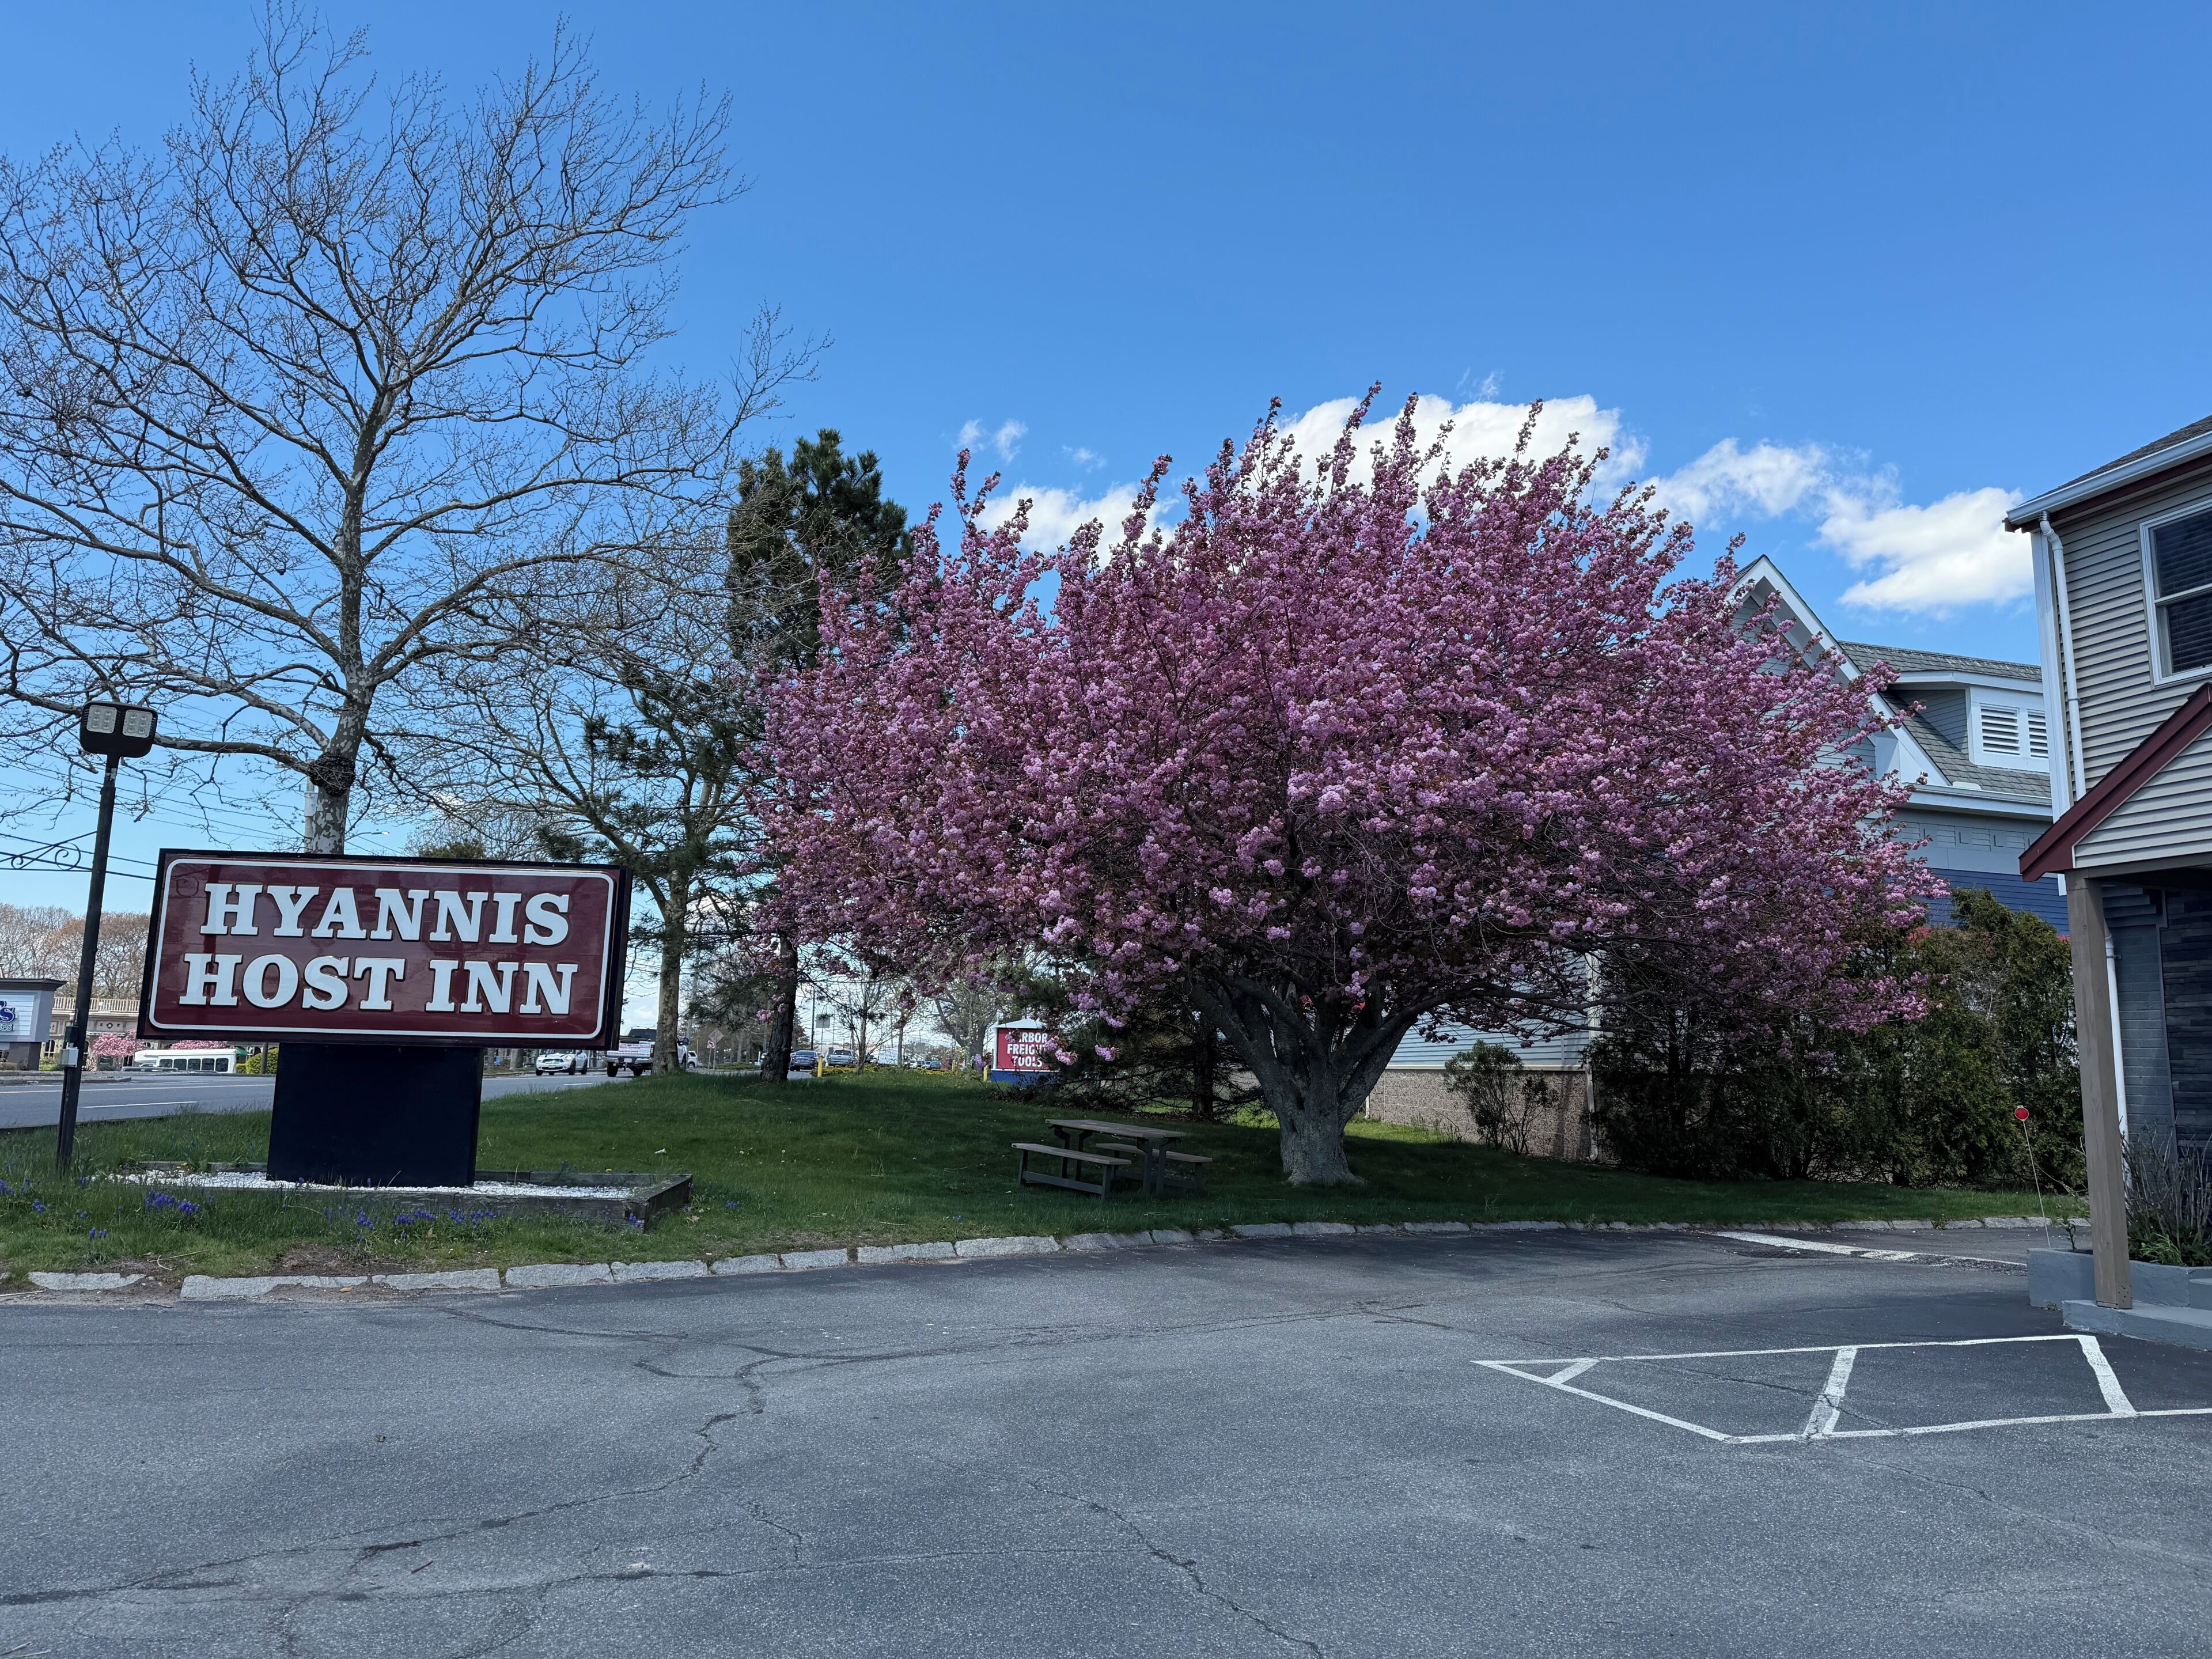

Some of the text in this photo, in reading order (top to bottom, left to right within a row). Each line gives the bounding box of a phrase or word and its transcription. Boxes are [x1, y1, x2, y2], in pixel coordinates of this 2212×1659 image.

[200, 882, 570, 945] HYANNIS
[179, 953, 578, 1014] HOST INN
[1006, 1032, 1048, 1043] RBOR
[1012, 1056, 1042, 1067] TOOLS
